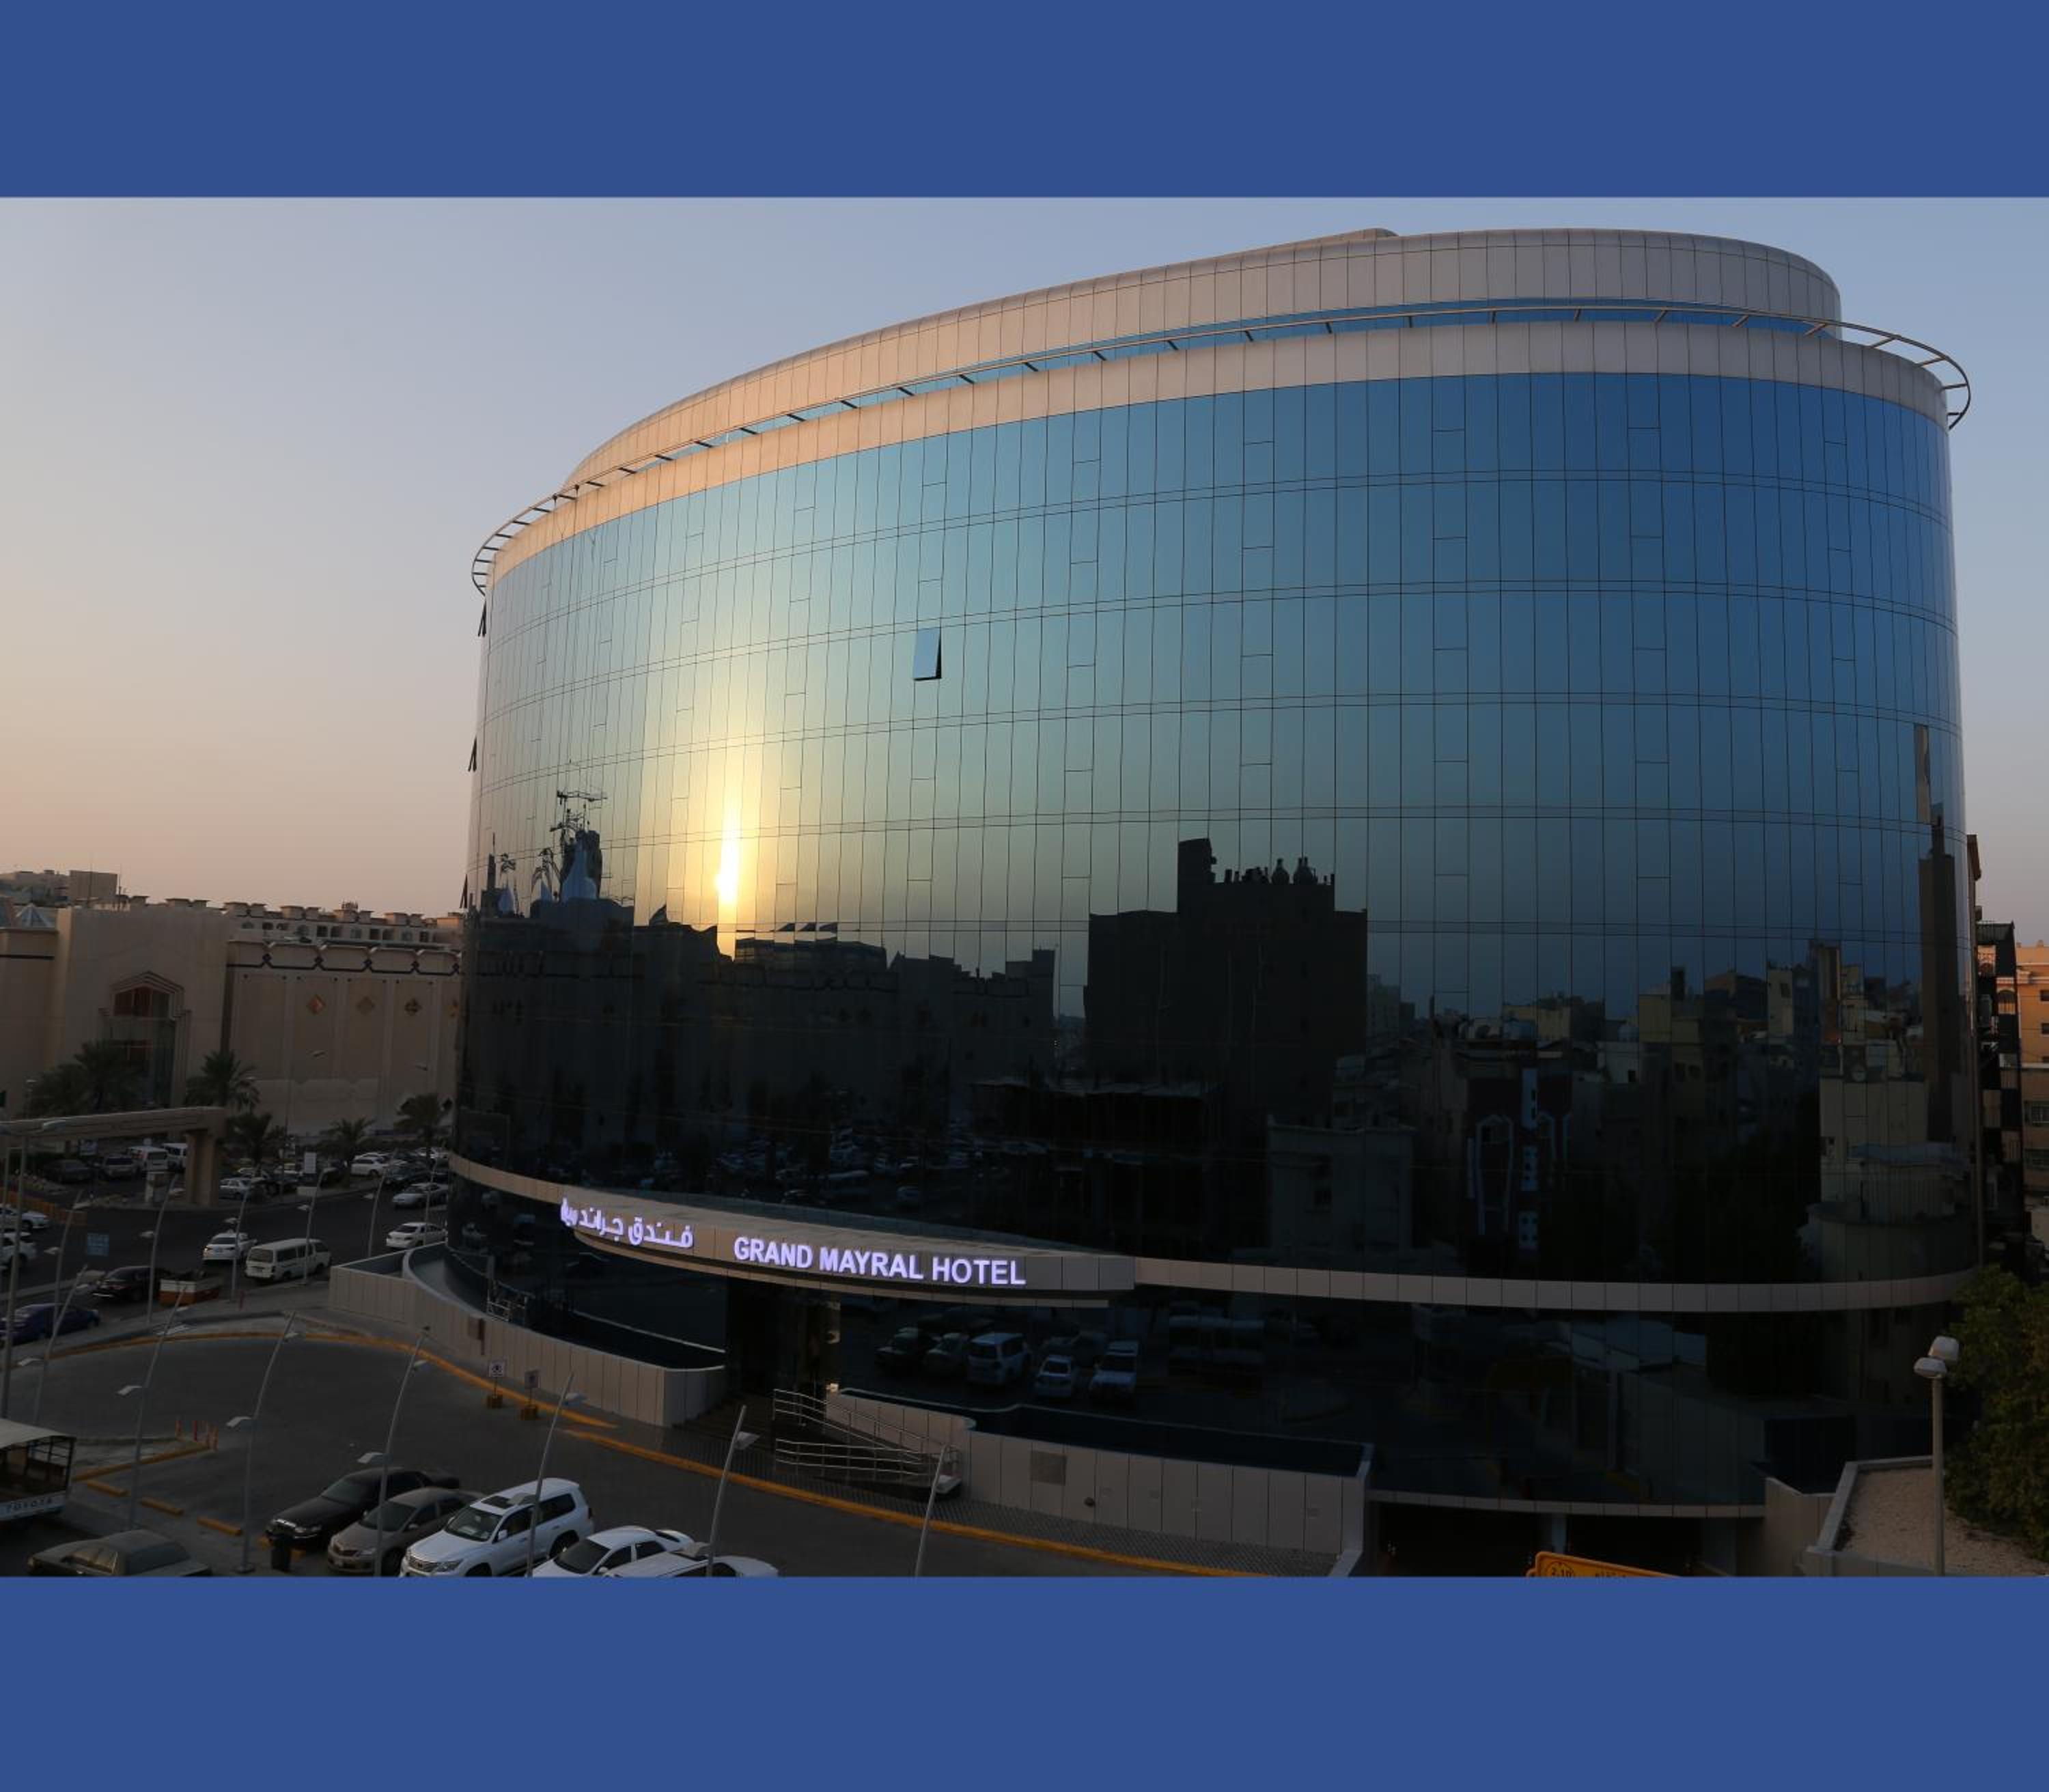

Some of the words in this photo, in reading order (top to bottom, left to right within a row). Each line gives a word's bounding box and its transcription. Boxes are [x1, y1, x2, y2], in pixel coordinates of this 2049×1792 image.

[579, 1207, 624, 1242] جراند
[628, 1216, 694, 1248] فندق
[734, 1236, 813, 1268] GRAND
[820, 1246, 924, 1280] MAYRAL
[932, 1256, 1027, 1285] HOTEL
